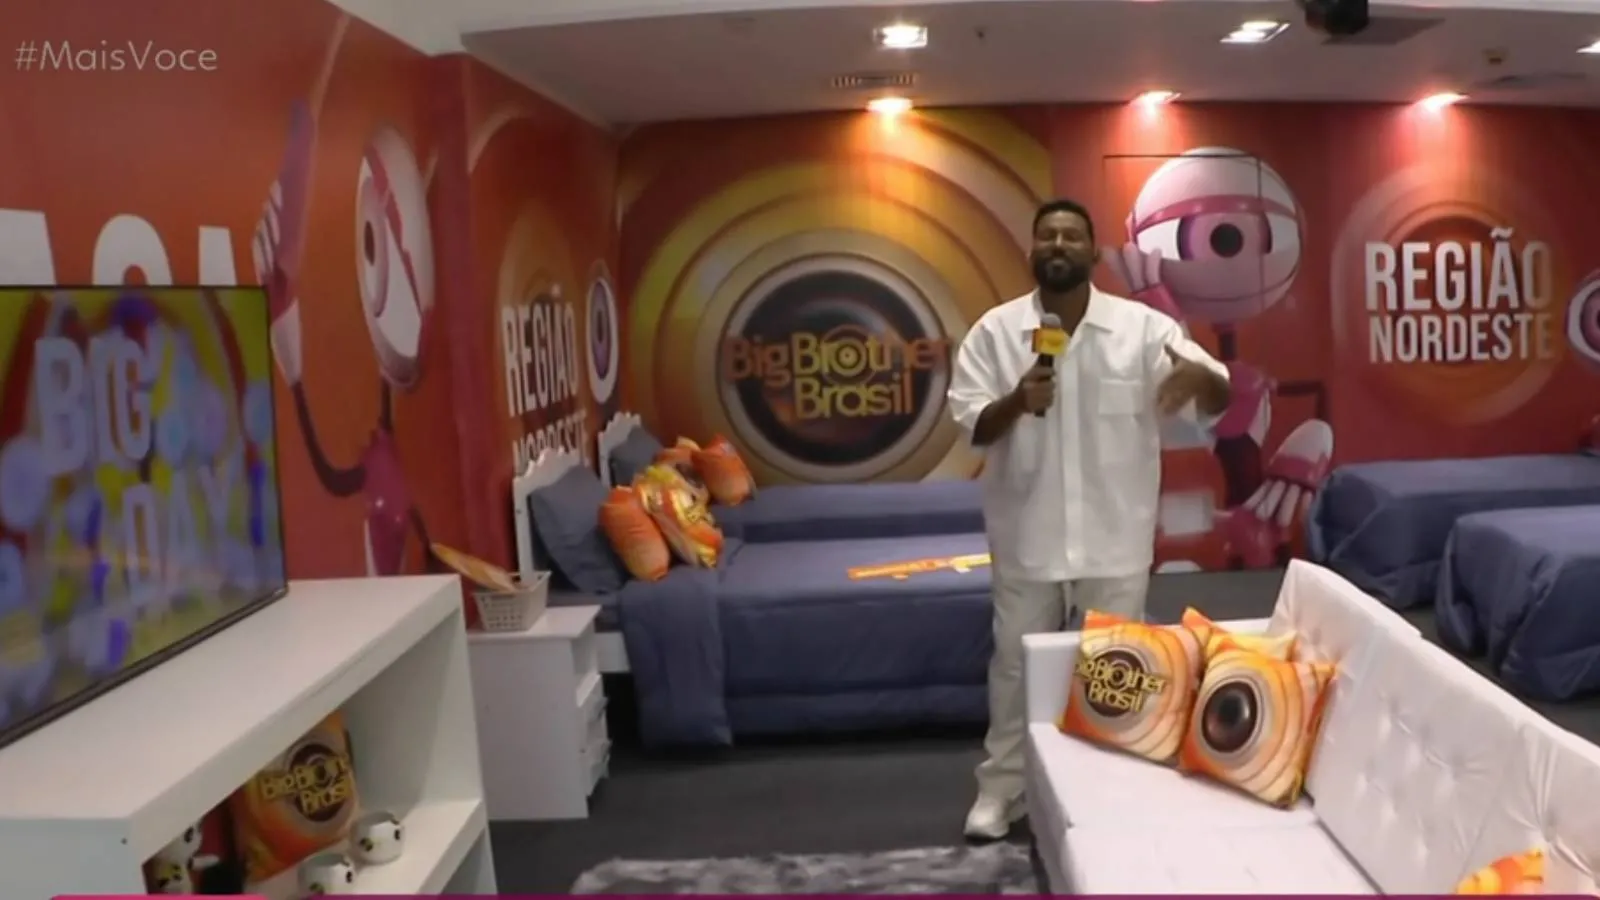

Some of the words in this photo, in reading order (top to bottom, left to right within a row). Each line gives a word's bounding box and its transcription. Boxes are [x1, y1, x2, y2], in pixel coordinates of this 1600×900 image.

[1364, 226, 1553, 311] REGIÃO
[501, 284, 580, 417] REGIÃO
[722, 335, 792, 390] Big
[1369, 313, 1555, 363] NORDESTE
[795, 372, 914, 420] Brasil
[1087, 679, 1145, 713] Brasil
